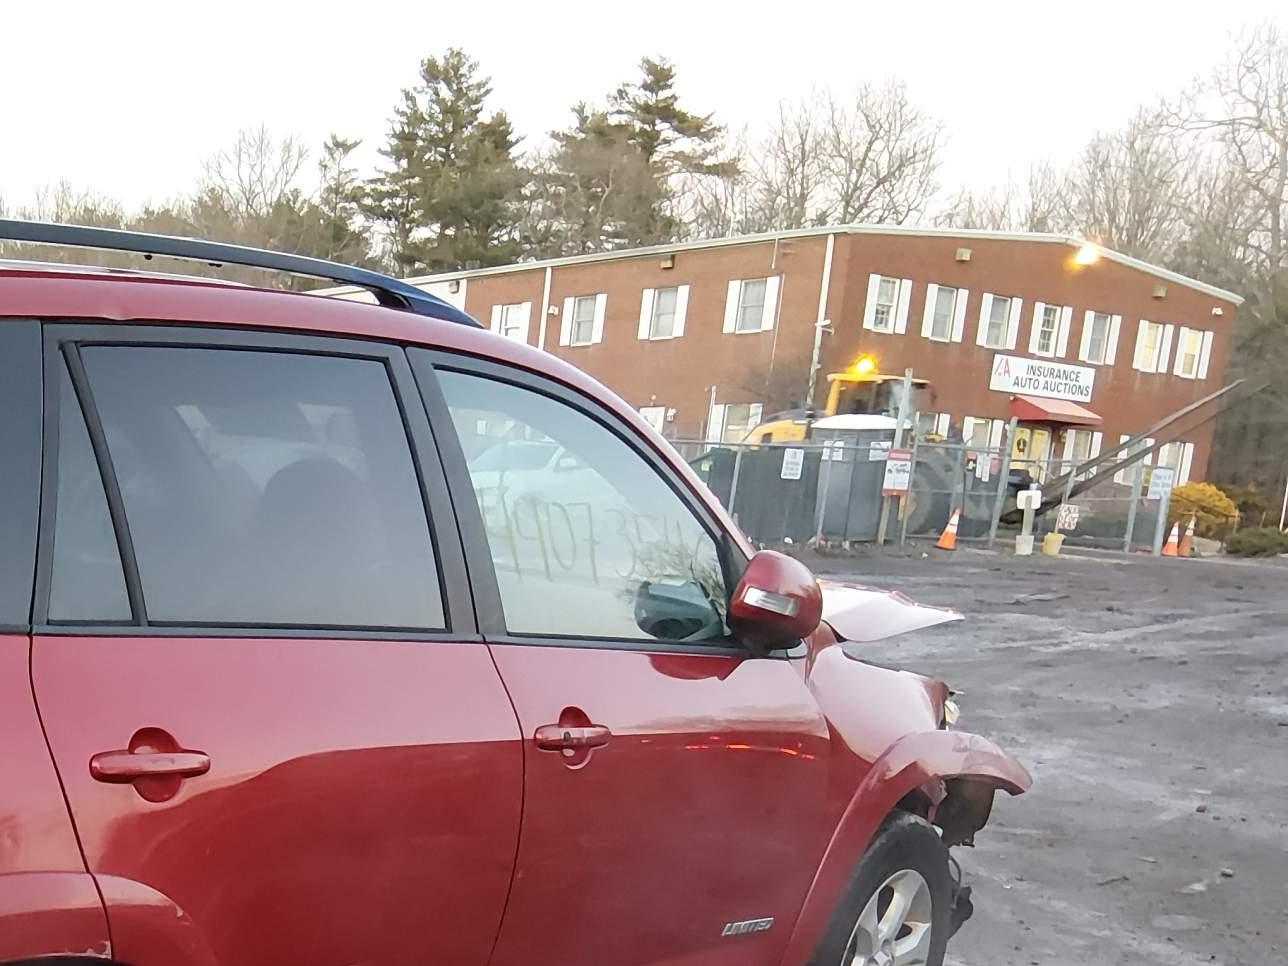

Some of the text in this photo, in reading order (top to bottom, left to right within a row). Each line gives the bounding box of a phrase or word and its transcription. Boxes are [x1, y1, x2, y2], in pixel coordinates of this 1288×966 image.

[1026, 363, 1081, 383] INSURANCE
[1012, 376, 1091, 397] AUTO AUCTIONS
